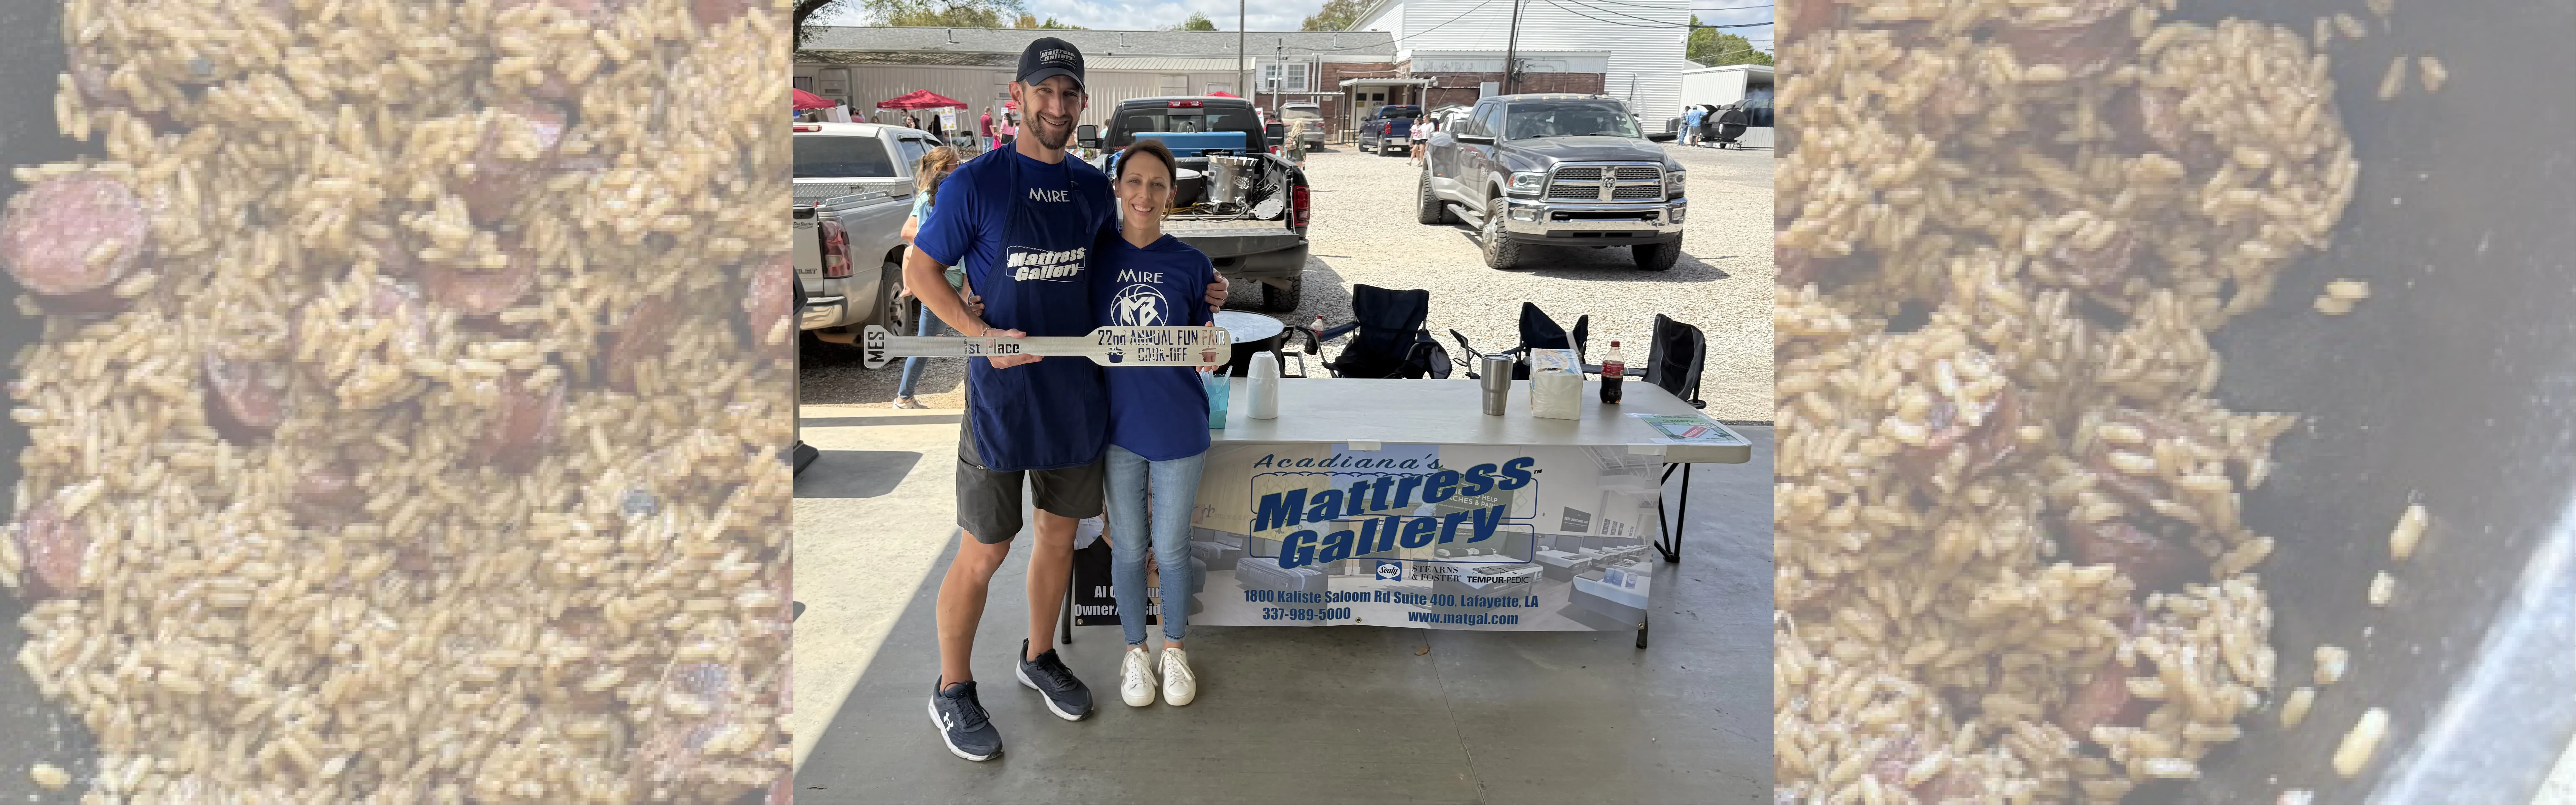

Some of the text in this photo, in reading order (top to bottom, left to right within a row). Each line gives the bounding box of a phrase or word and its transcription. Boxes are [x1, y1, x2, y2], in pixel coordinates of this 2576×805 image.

[1041, 49, 1074, 58] Mattress
[1029, 188, 1070, 202] MIRE
[1008, 247, 1085, 267] Mattress
[1015, 263, 1079, 281] Gallery
[1117, 269, 1164, 283] MIRE
[1098, 330, 1225, 345] 22nd ANNUAL FUN FAIR
[868, 331, 884, 362] MES
[964, 339, 1019, 354] 1st Place
[1138, 347, 1187, 362] COOK-OFF
[1253, 453, 1444, 469] Acadiana's
[1253, 457, 1534, 532] Mattress
[1279, 504, 1506, 569] Gallery
[1379, 566, 1398, 576] Sealy
[1412, 565, 1458, 573] STEARNS
[1244, 590, 1538, 608] 1800 Kaliste Saloom Rd Suite 400, Lafayette, LA
[1262, 607, 1350, 621] 337-989-5000
[1408, 612, 1518, 626] www.matgal.com
